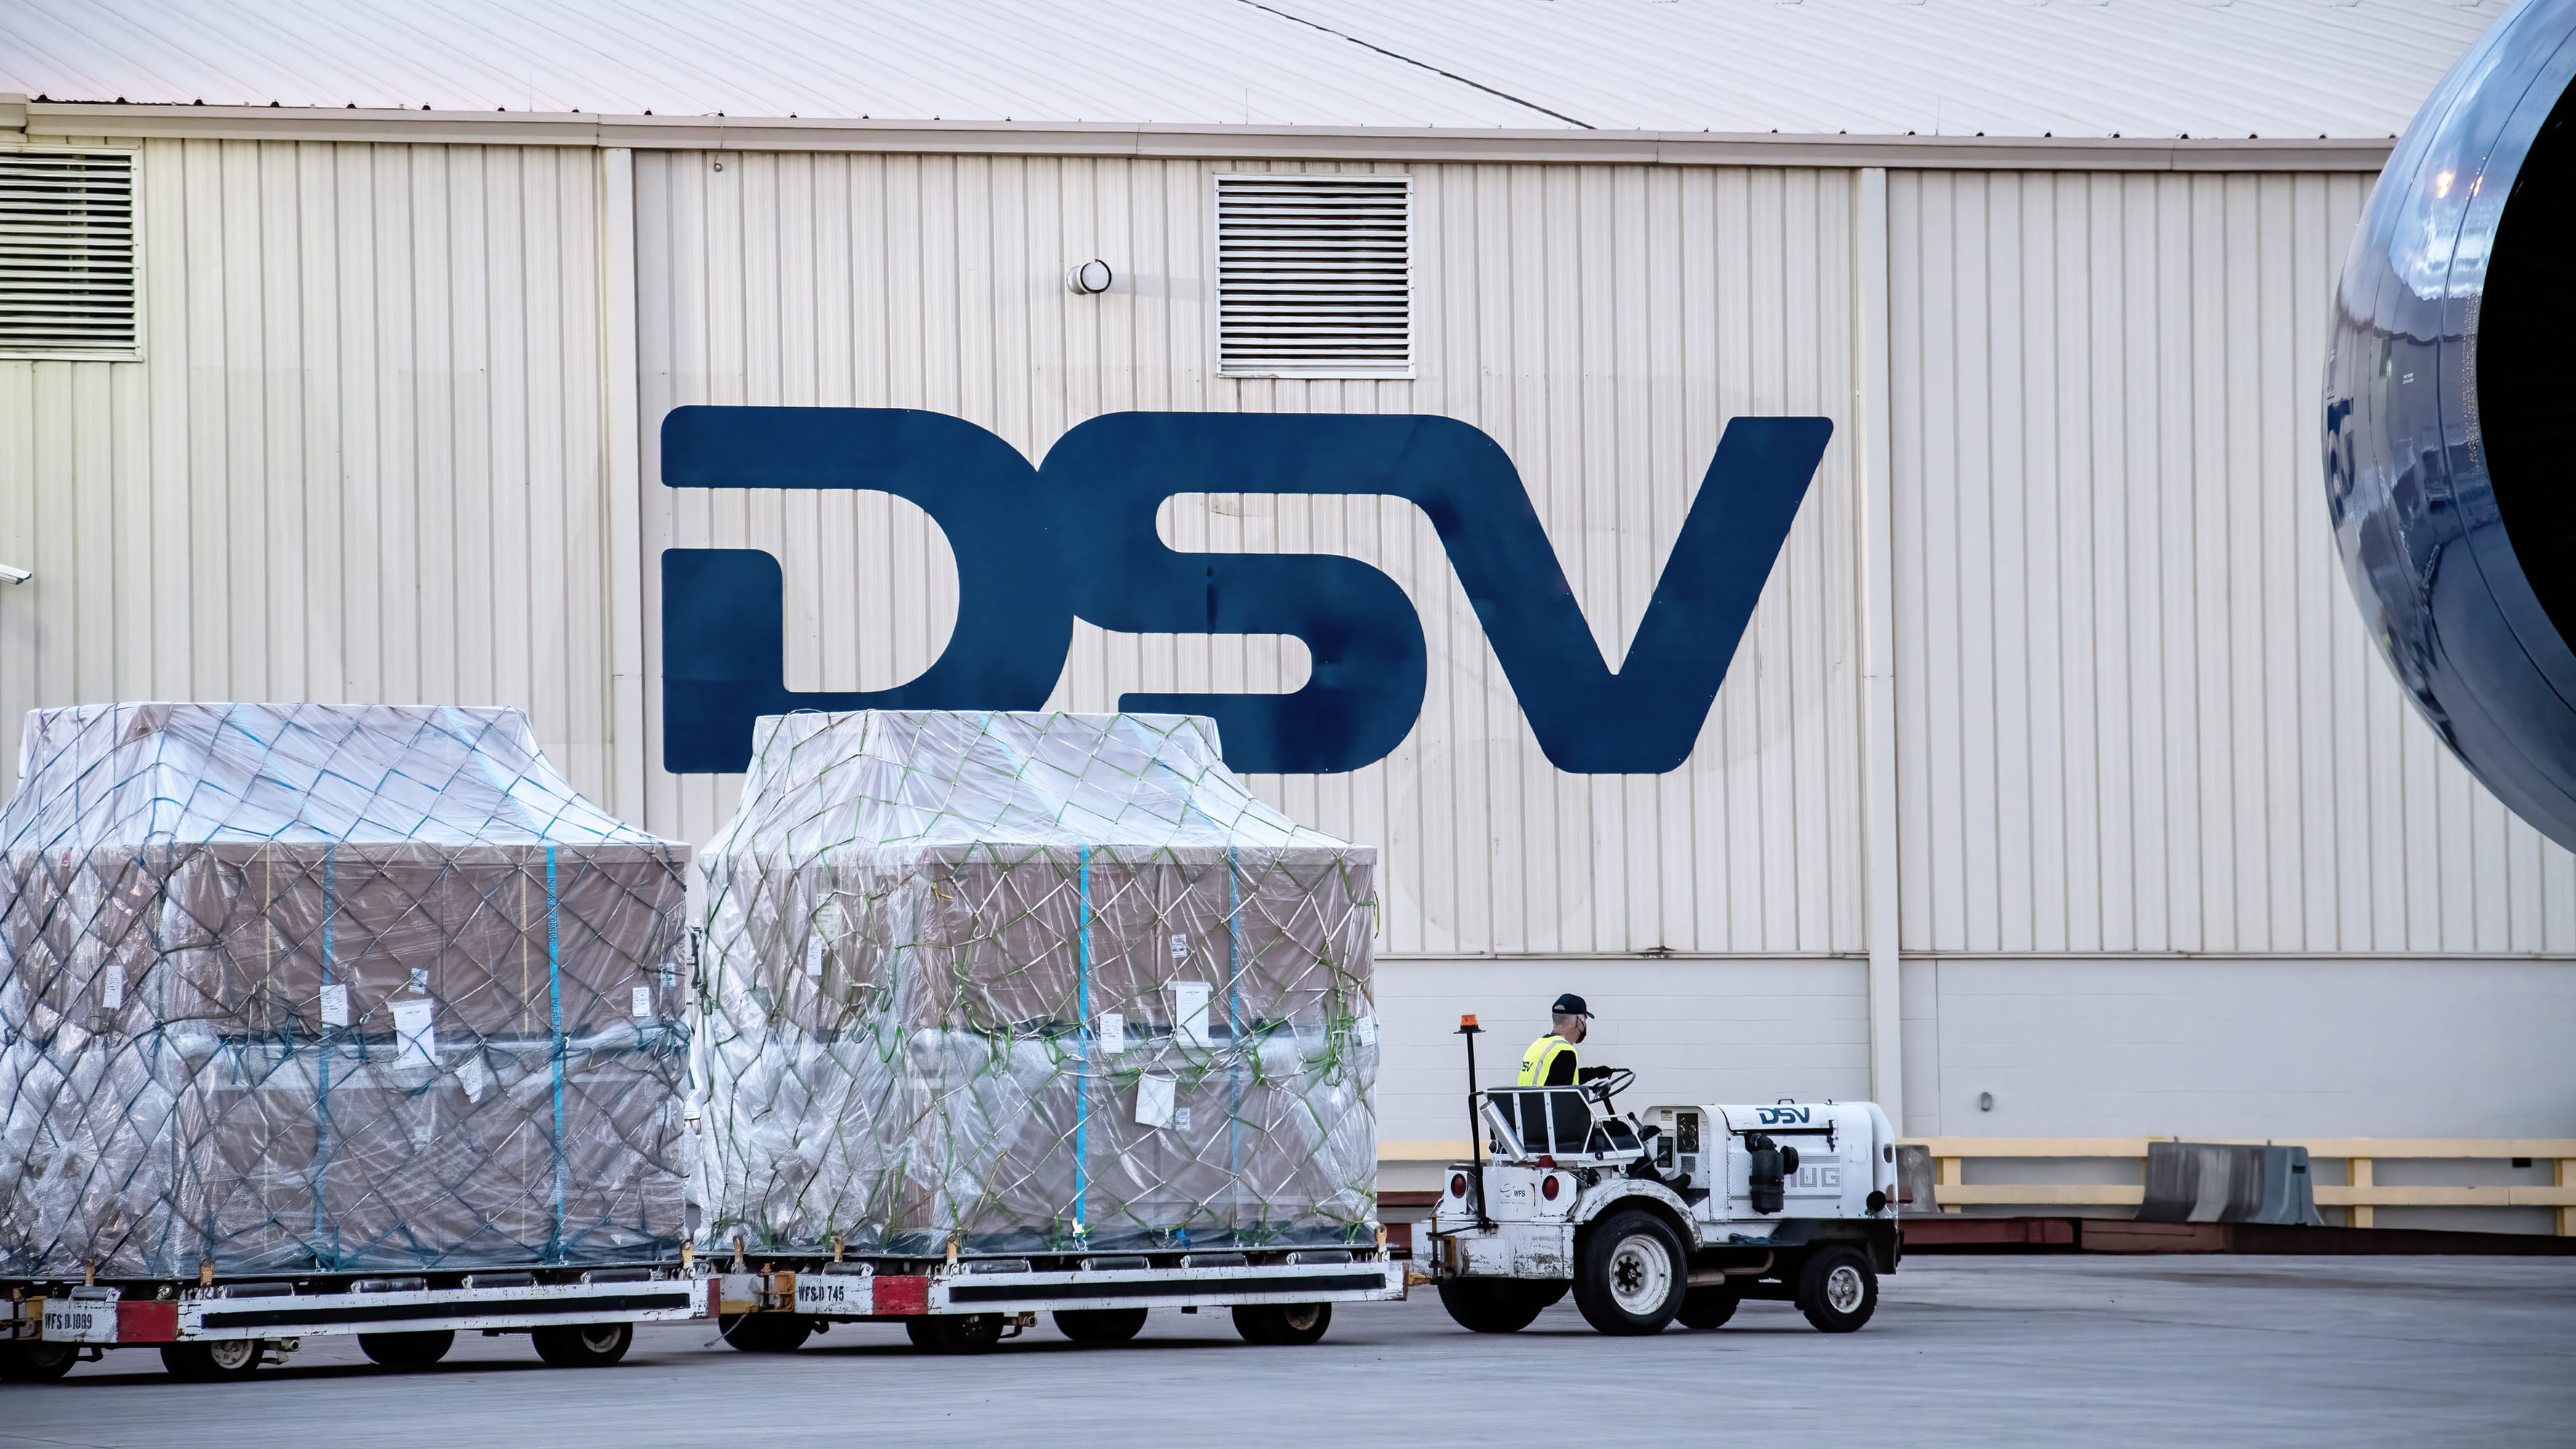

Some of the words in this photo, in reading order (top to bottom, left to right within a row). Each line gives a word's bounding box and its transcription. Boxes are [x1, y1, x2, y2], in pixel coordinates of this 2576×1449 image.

[661, 404, 1834, 773] DSV
[1522, 1061, 1533, 1072] SV
[1755, 1107, 1810, 1124] DSV
[827, 1285, 844, 1301] 745
